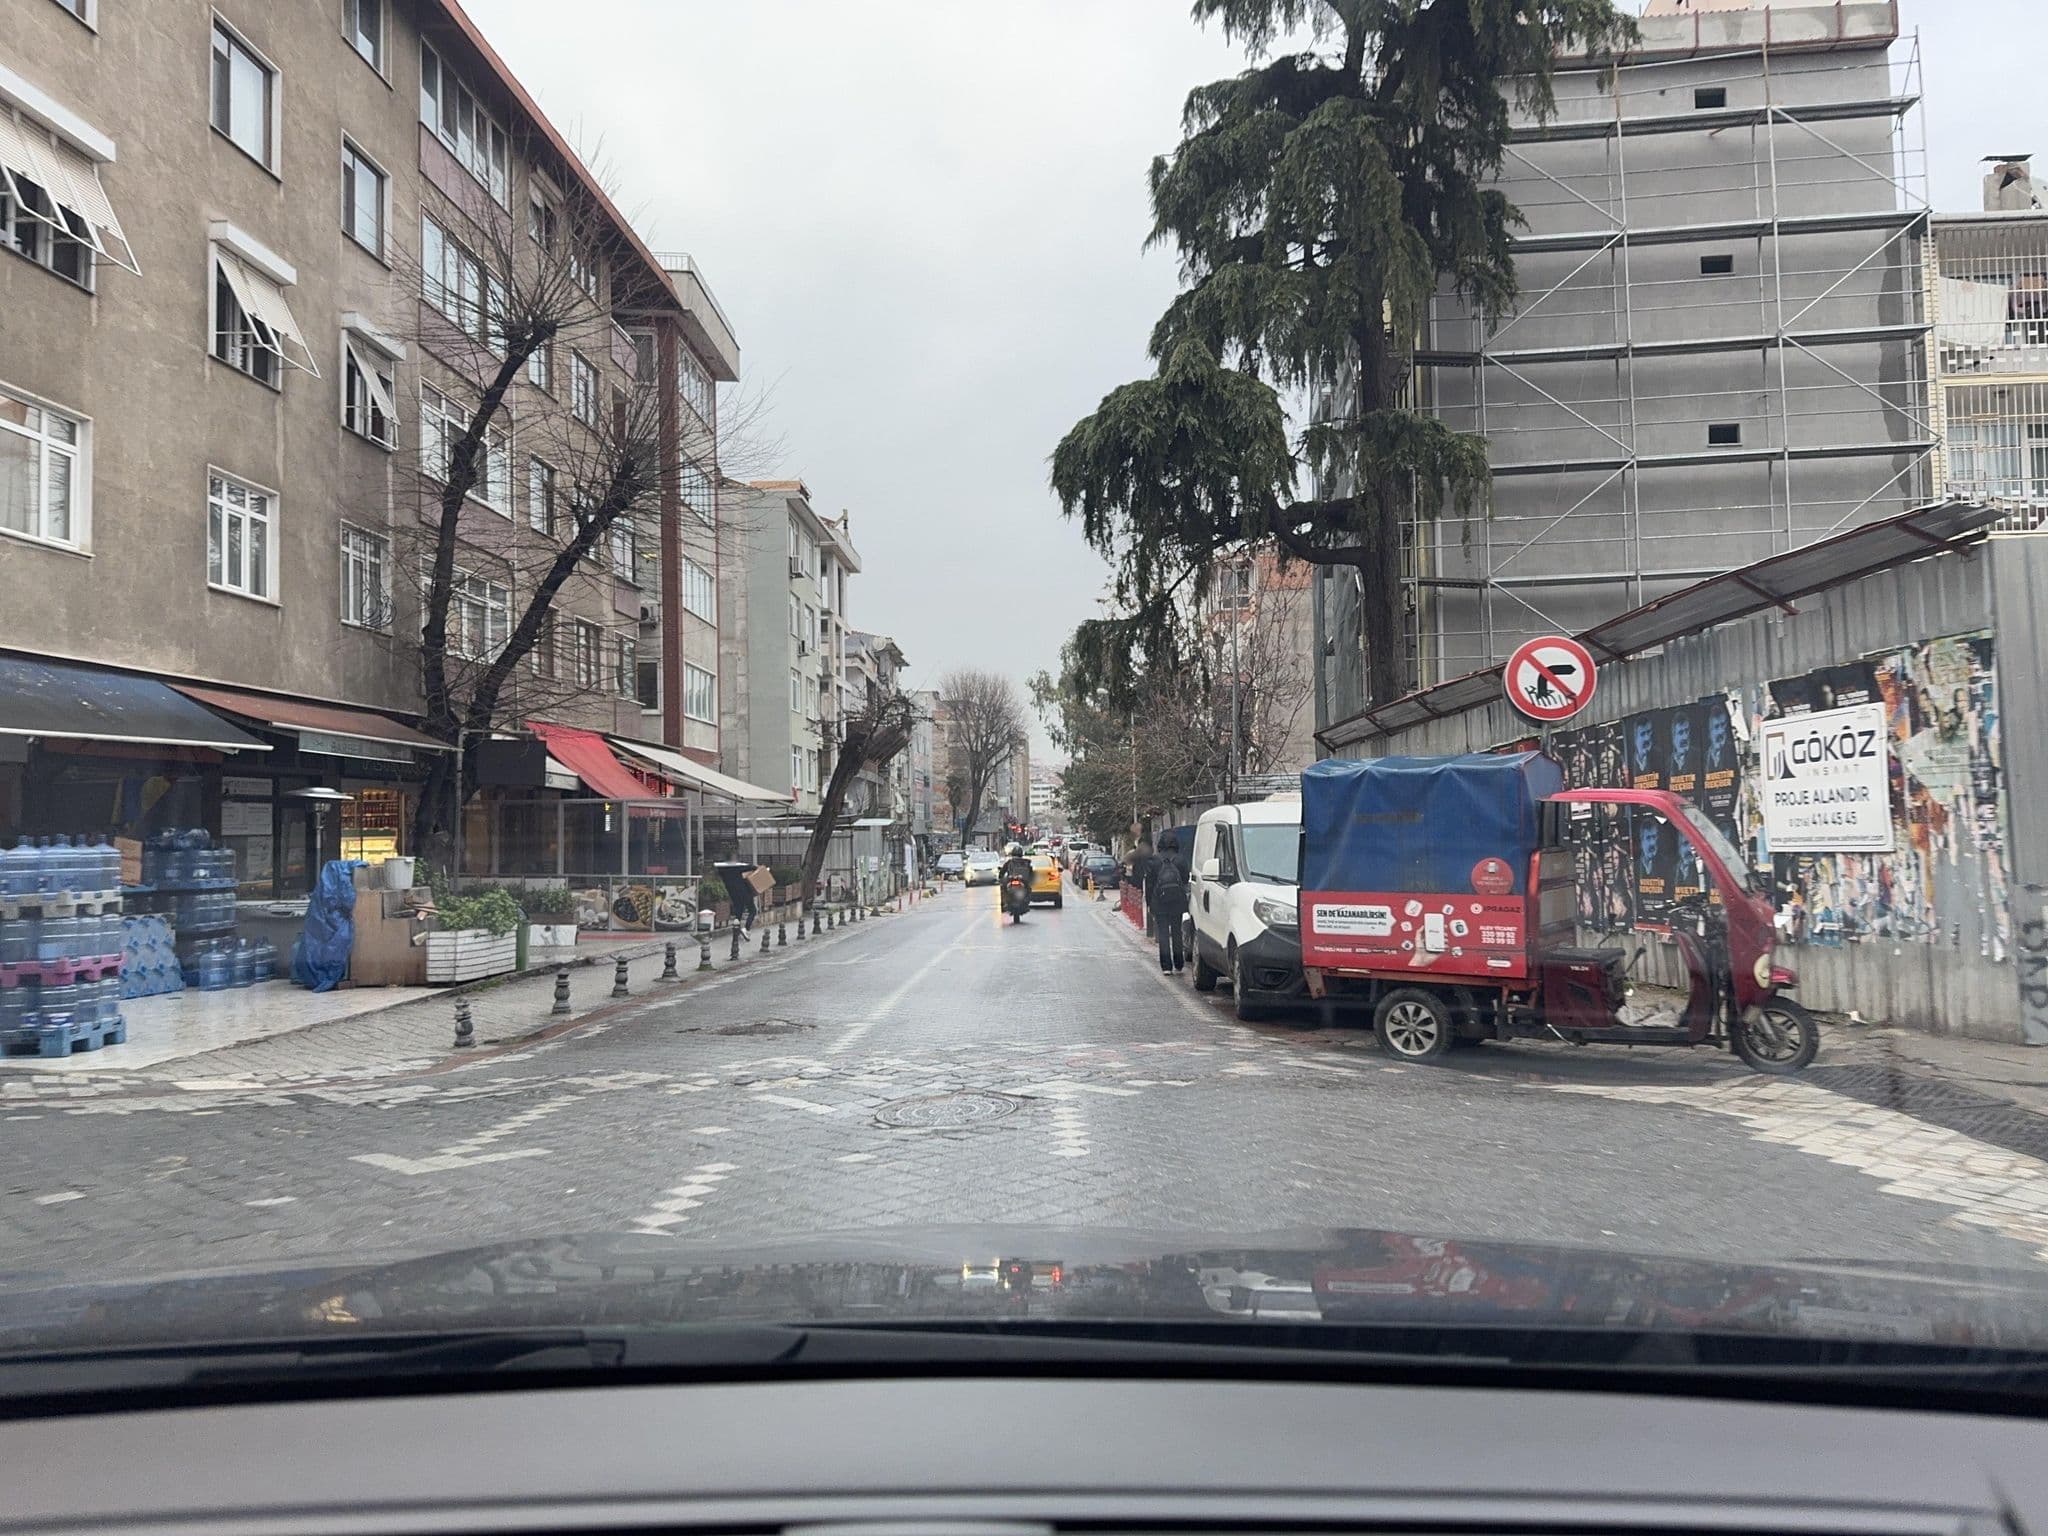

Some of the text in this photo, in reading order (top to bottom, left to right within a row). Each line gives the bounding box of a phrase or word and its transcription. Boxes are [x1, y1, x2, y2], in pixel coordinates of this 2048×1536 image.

[1774, 785, 1870, 807] PROJE ALANIDIR
[1811, 812, 1830, 827] 414
[1831, 811, 1843, 826] 45
[1845, 810, 1858, 826] 45
[1316, 909, 1328, 918] SEN
[1328, 909, 1337, 918] DE
